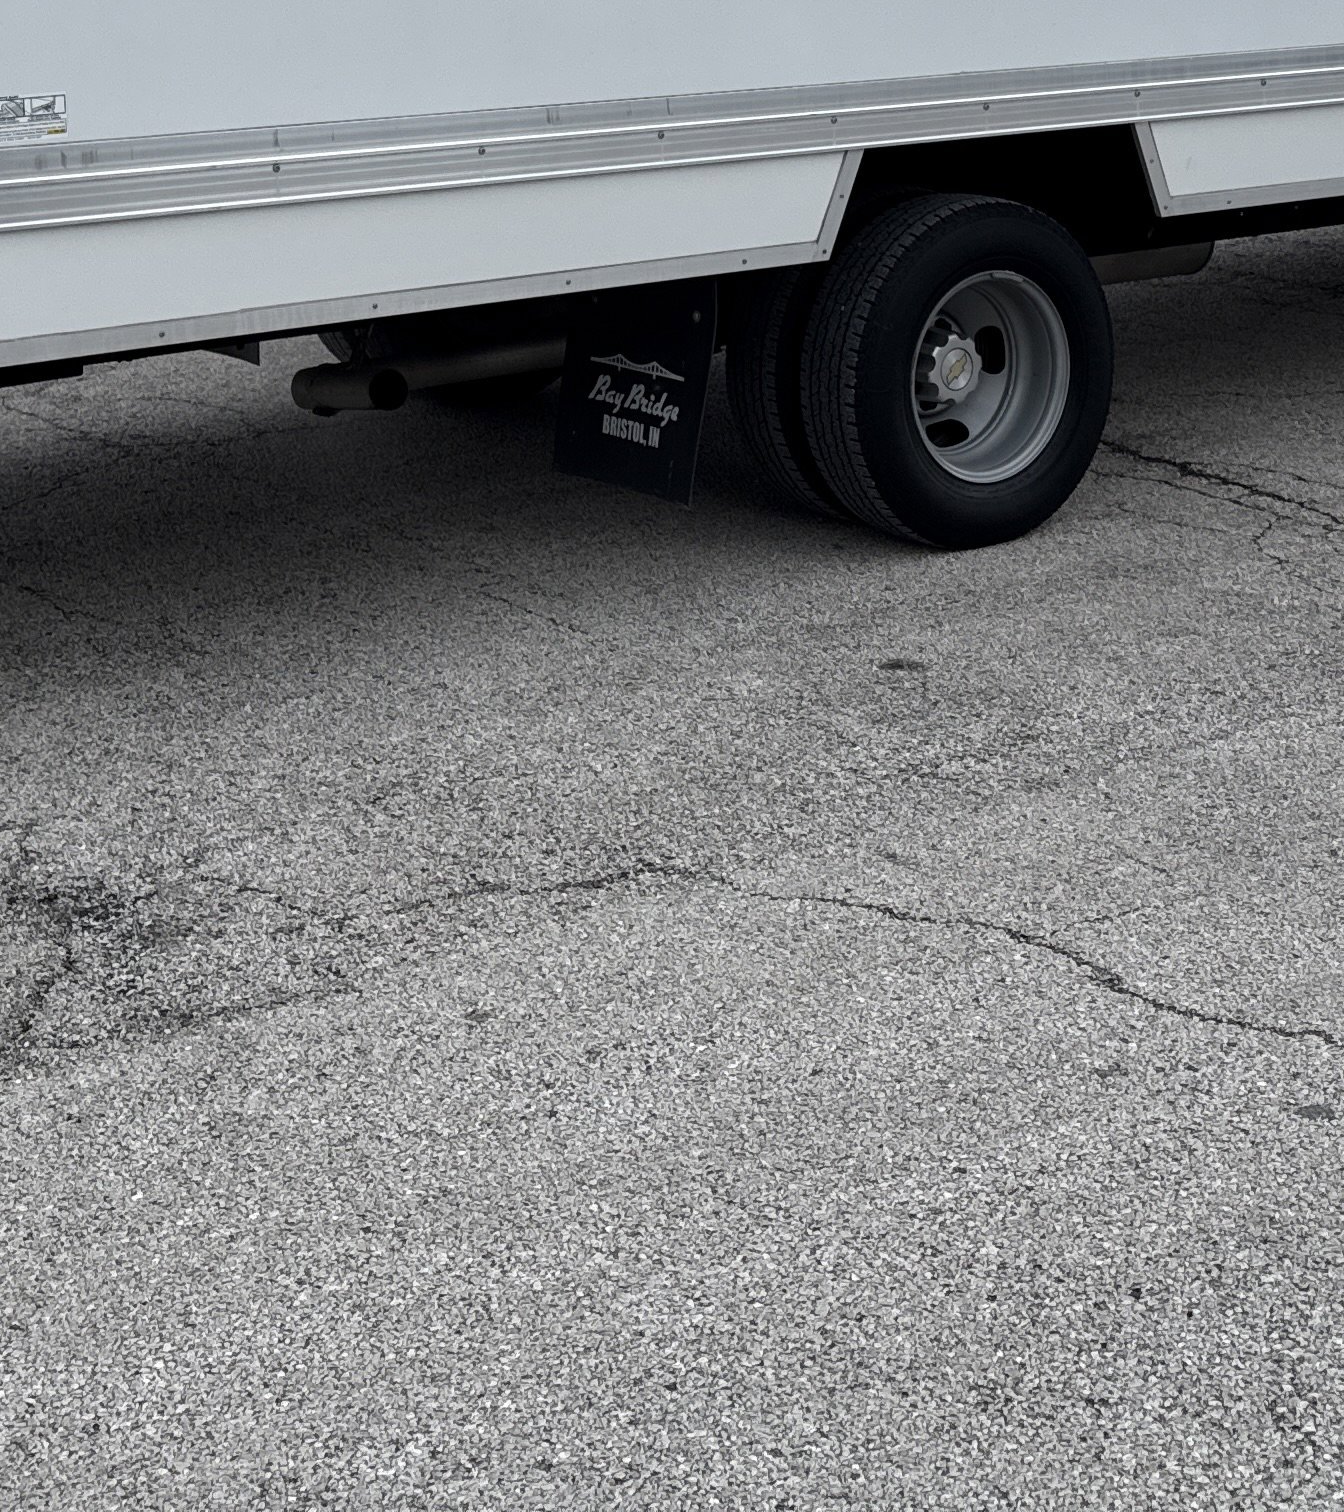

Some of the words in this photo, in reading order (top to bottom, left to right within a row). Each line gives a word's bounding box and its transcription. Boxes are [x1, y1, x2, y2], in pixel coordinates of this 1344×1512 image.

[588, 374, 624, 414] Bay
[623, 383, 679, 427] Bridge
[602, 414, 646, 447] BRISTOL,
[648, 426, 660, 448] IN
